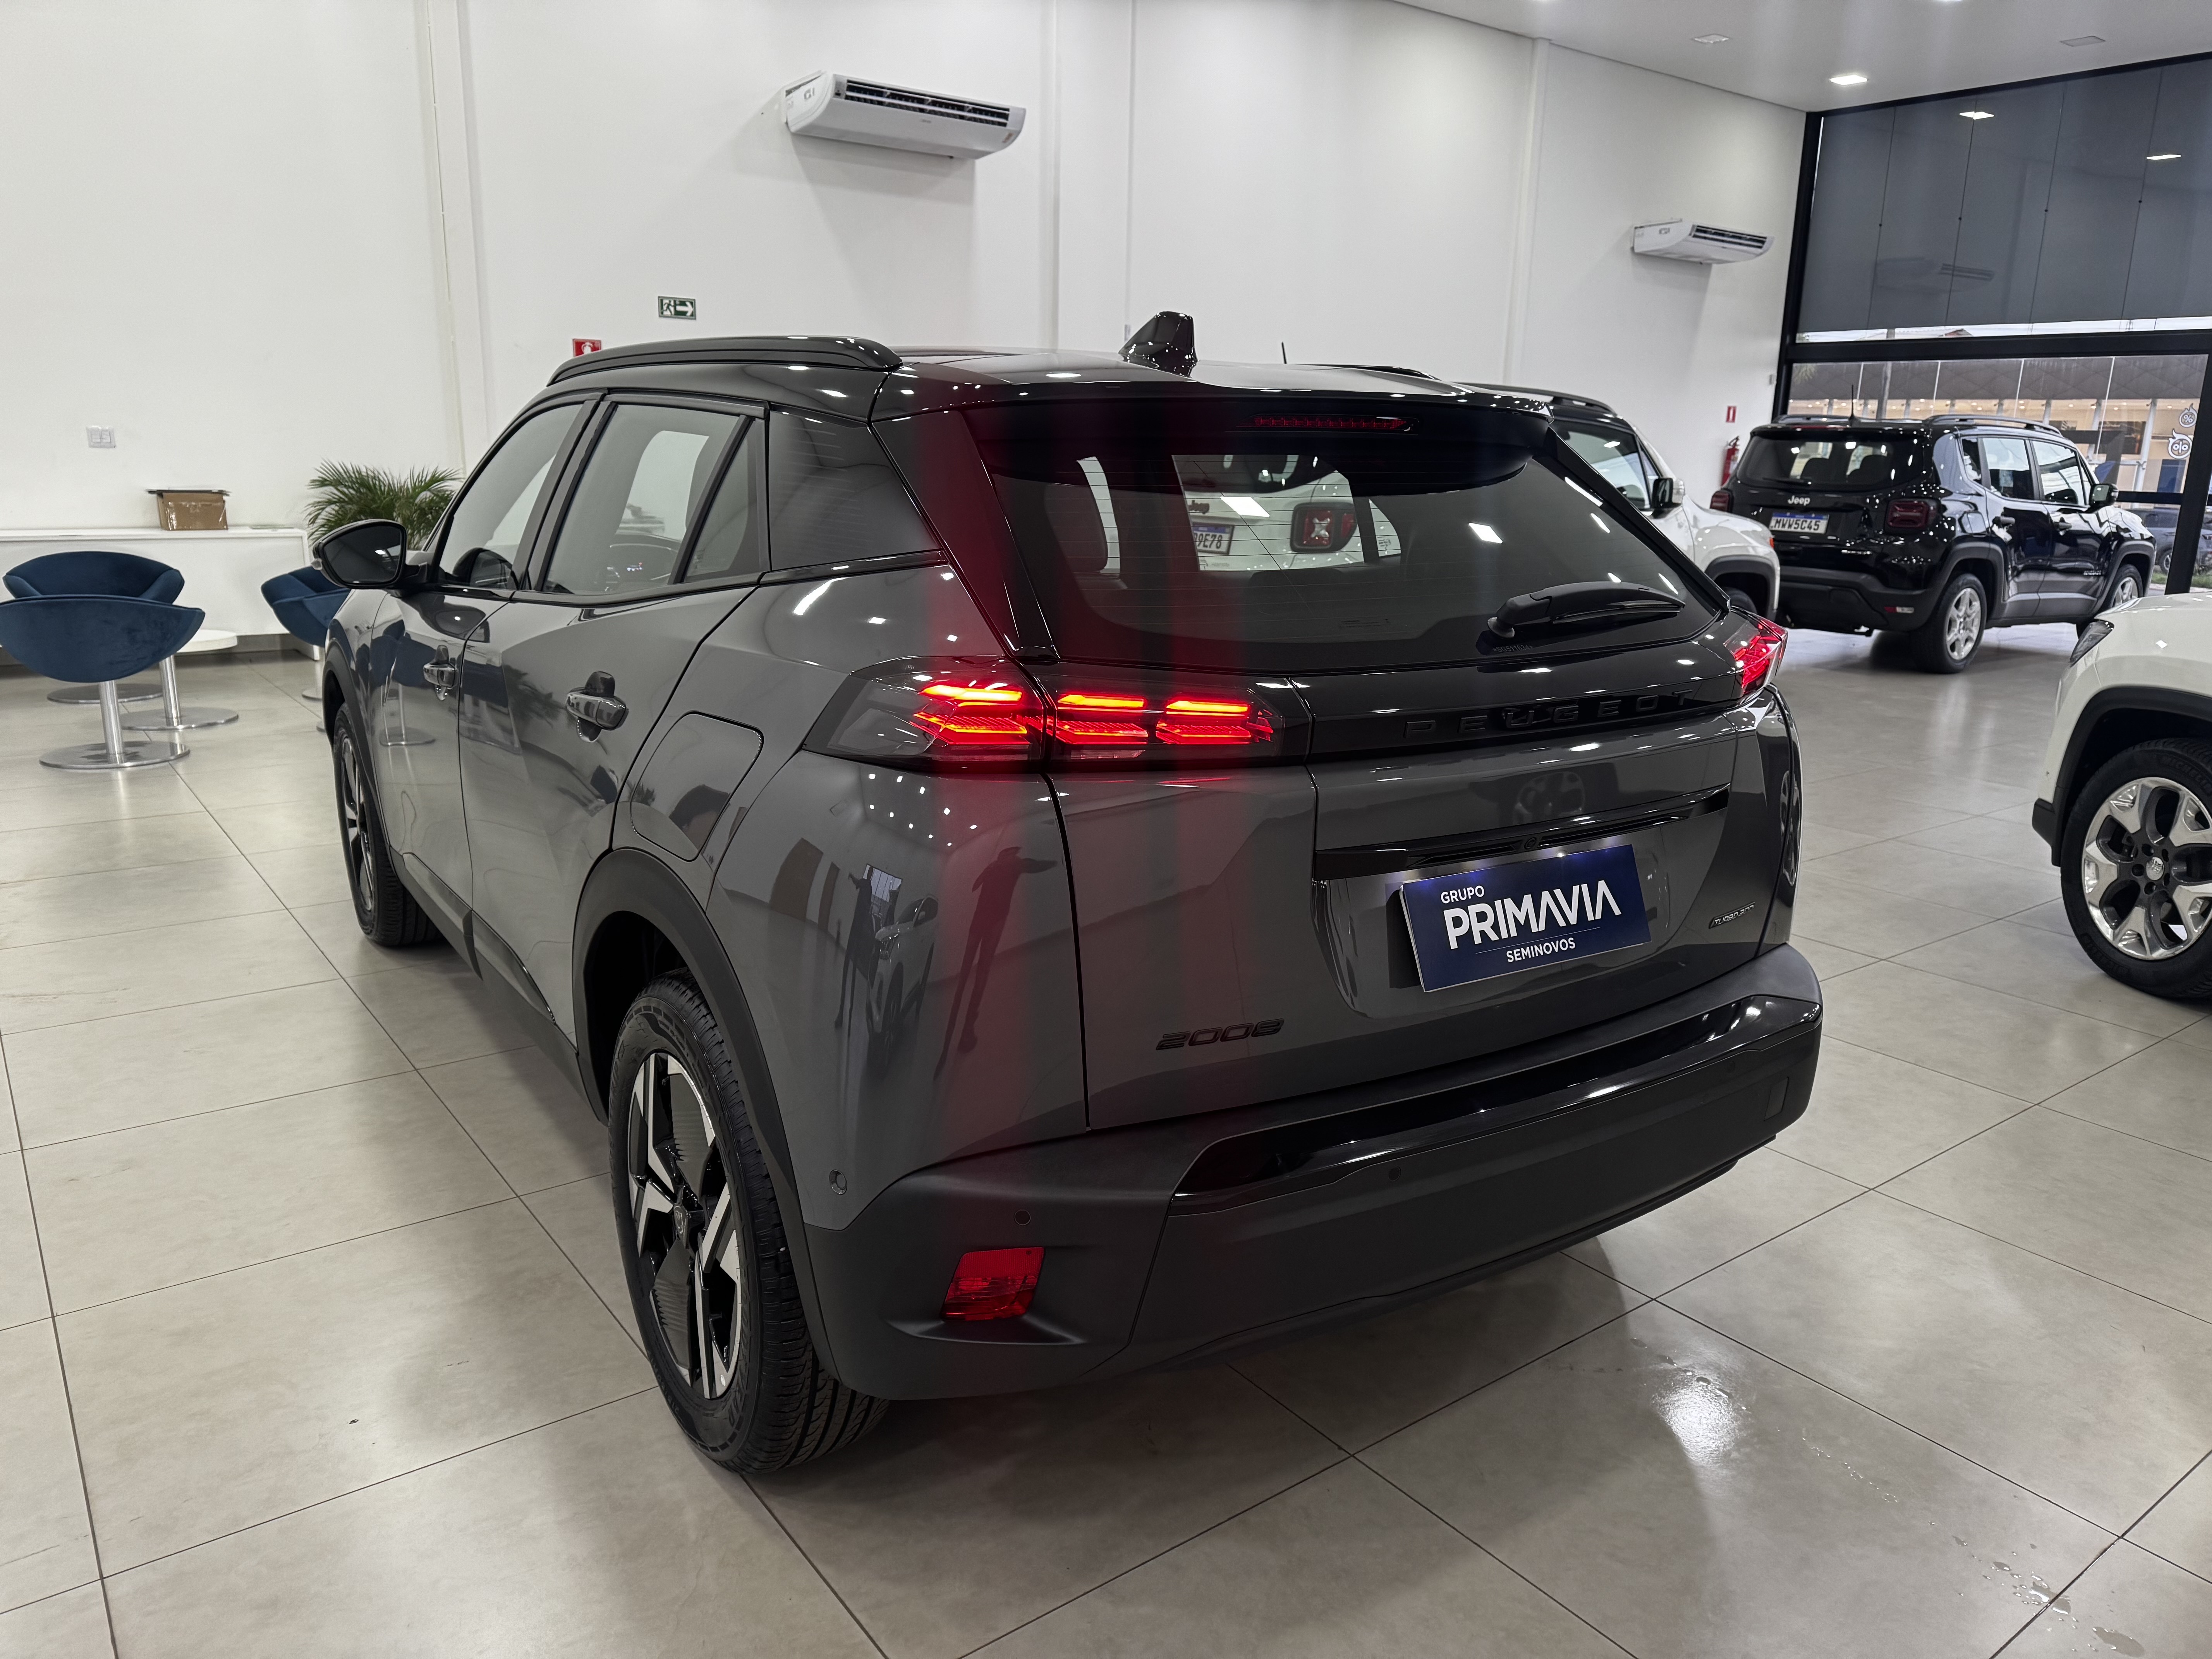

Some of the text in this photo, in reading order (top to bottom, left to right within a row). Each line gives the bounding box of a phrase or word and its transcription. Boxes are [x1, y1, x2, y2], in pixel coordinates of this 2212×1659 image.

[1788, 495, 1810, 506] Jeep
[1403, 689, 1693, 738] PEUGEOT
[1441, 885, 1485, 904] GRUPO
[1443, 880, 1621, 950] PRIMAVIA
[1506, 938, 1576, 962] SEMINOVOS
[1156, 1018, 1285, 1051] 2008
